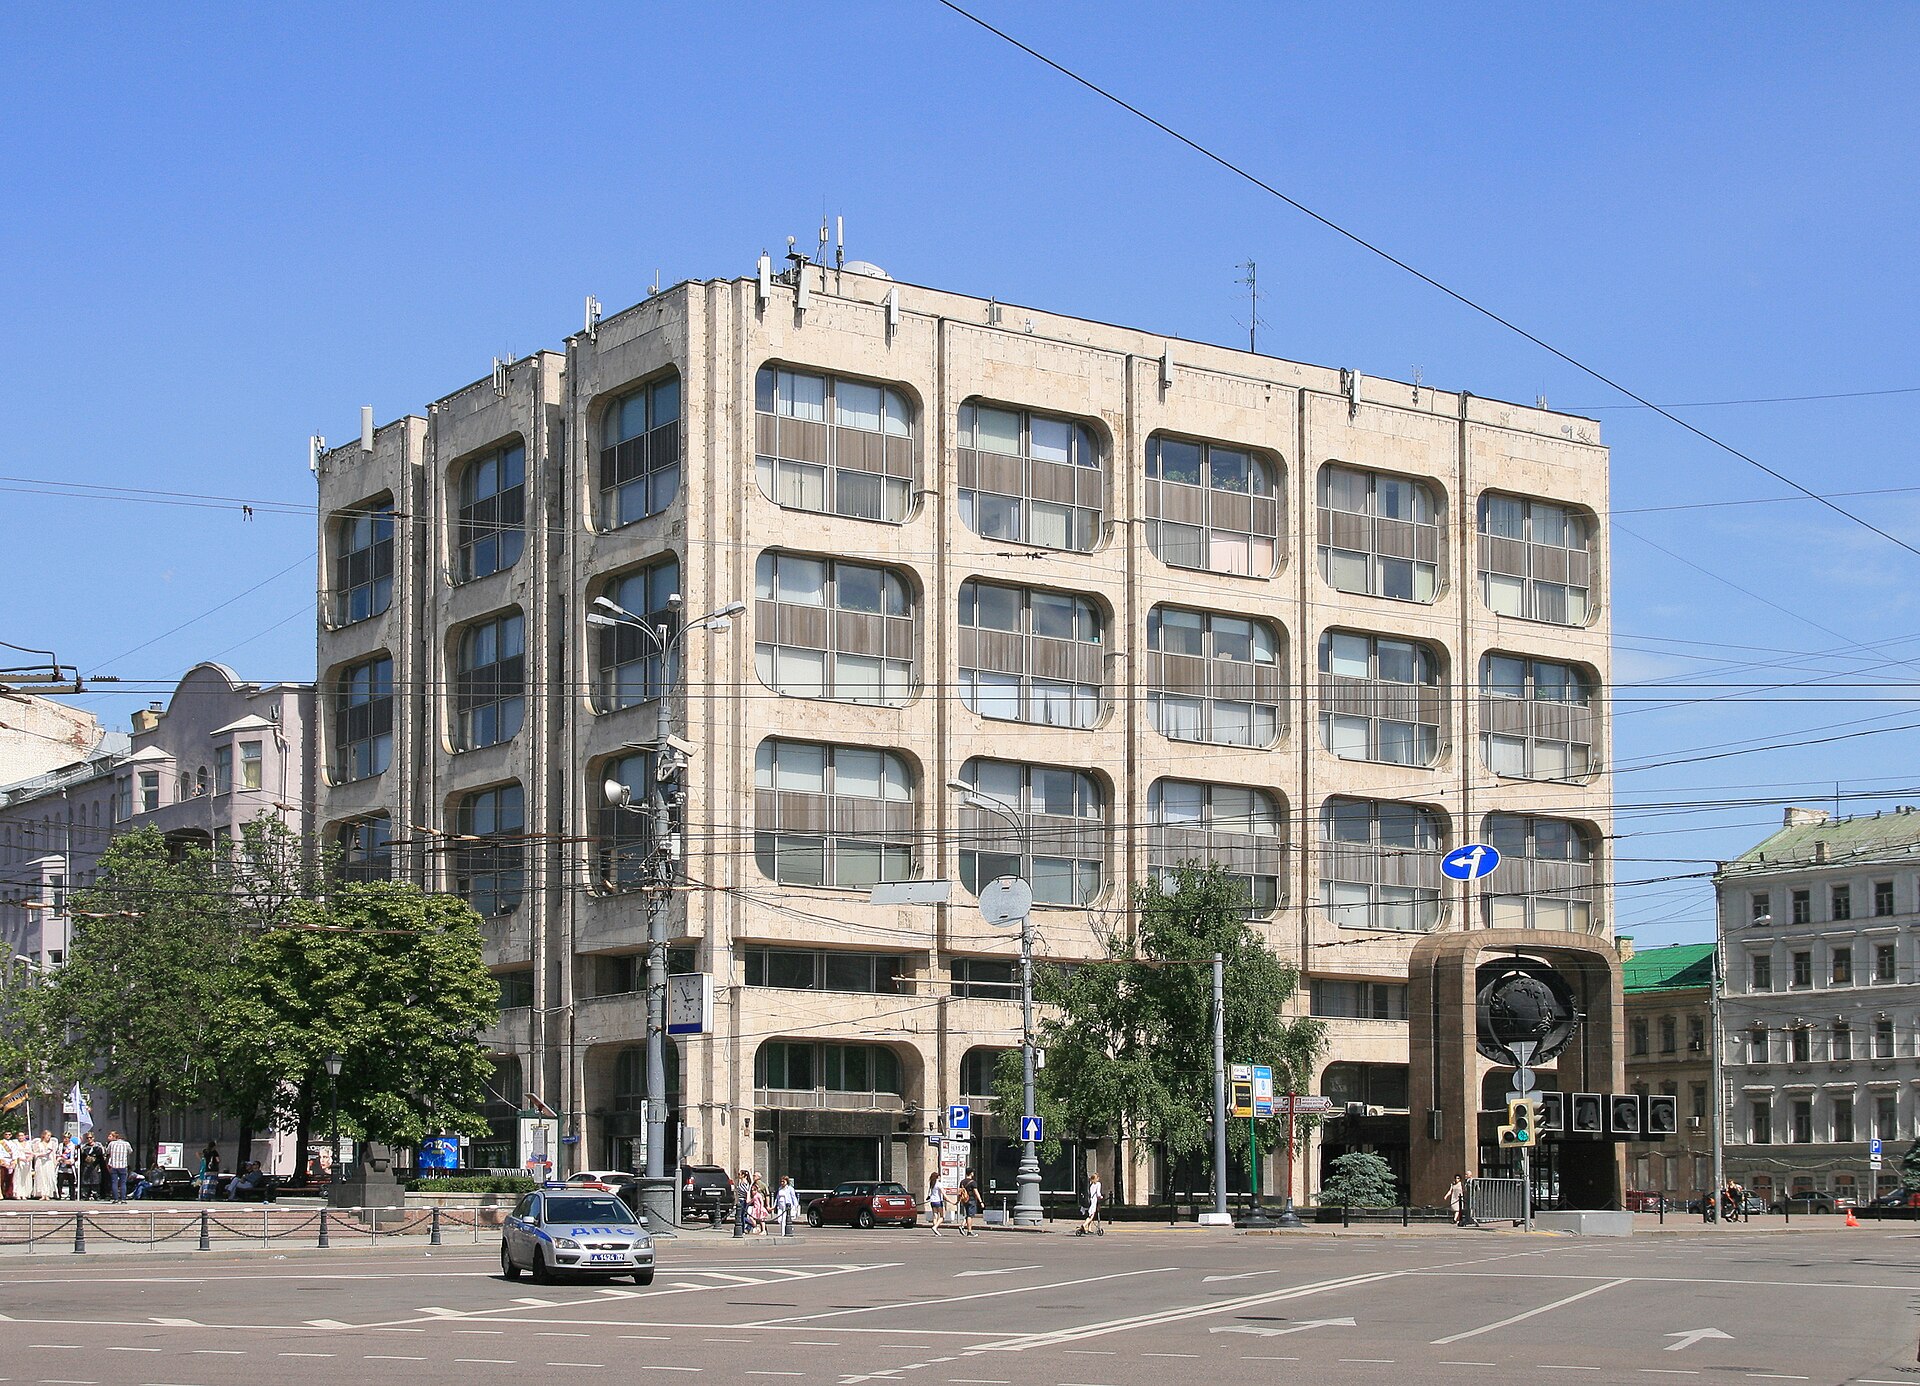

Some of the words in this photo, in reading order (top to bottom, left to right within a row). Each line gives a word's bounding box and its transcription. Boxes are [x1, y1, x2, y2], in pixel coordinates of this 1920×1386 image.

[953, 1107, 965, 1127] P
[1872, 1140, 1879, 1152] P
[571, 1227, 635, 1236] ДПС
